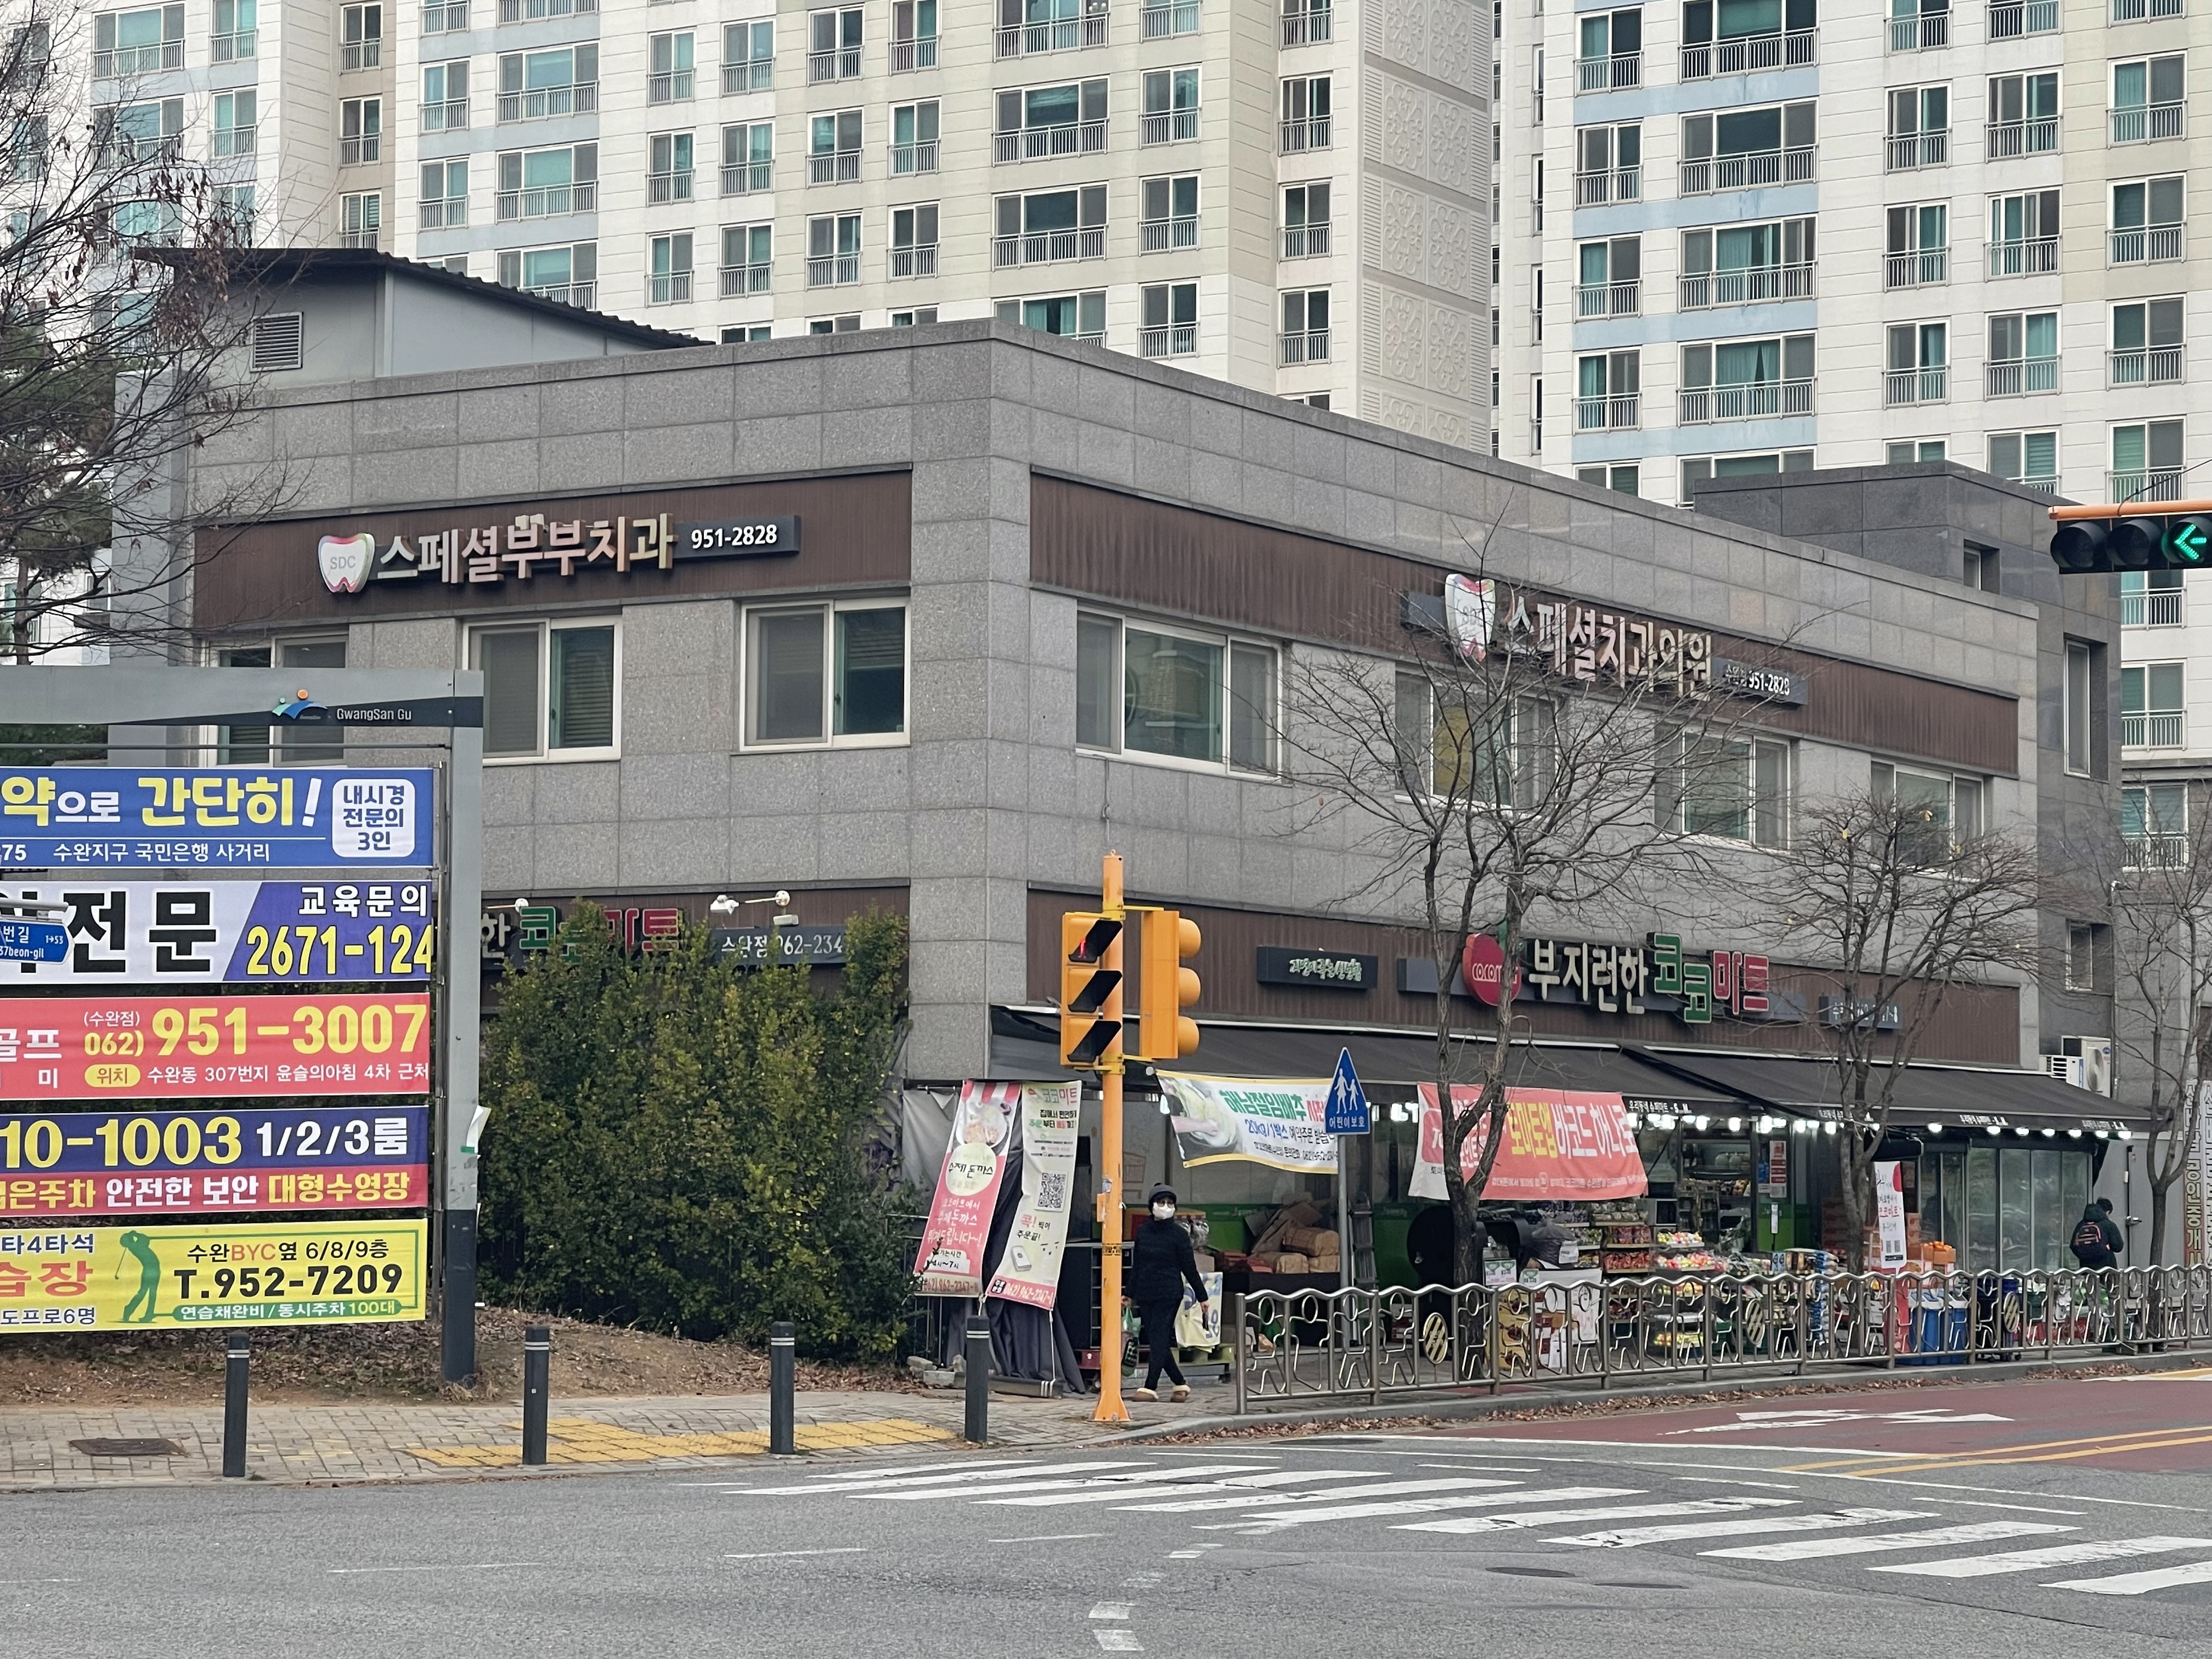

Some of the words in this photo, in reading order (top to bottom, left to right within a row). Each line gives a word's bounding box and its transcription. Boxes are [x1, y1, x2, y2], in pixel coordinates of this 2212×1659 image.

[377, 513, 674, 583] 스페셜부부치과
[691, 524, 778, 550] 951-2828
[329, 555, 356, 570] SDC
[336, 708, 394, 721] GwangSan
[397, 709, 412, 720] Gu
[138, 776, 322, 827] 간단히!
[343, 785, 405, 805] 내시경
[343, 808, 404, 827] 전문의
[53, 843, 128, 862] 수완지구
[134, 843, 209, 862] 국민은행
[216, 843, 270, 862] 사거리
[358, 831, 391, 851] 3인
[1528, 939, 1648, 1015] 부지런한
[1652, 932, 1770, 1024] 코코마트
[83, 1011, 140, 1027] (수완점)
[84, 1030, 144, 1057] 062)
[152, 1005, 427, 1056] 951-3007
[97, 1068, 128, 1085] 위치
[148, 1066, 197, 1084] 수완동
[205, 1065, 268, 1082] 307번지
[276, 1064, 356, 1082] 윤슬의아침
[364, 1064, 391, 1080] 4차
[398, 1062, 429, 1080] 근처
[1041, 1087, 1077, 1105] 코코마트
[1219, 1090, 1307, 1121] 해남절임배추
[1329, 1116, 1365, 1128] 어린이보호
[256, 1117, 408, 1157] 1/2/3룸
[106, 1176, 193, 1207] 안전한
[203, 1176, 259, 1205] 보안
[268, 1172, 410, 1204] 대형수영장
[187, 1242, 297, 1263] 수완BYC옆
[306, 1239, 389, 1261] 6/8/9층
[174, 1263, 402, 1299] T.952-7209
[349, 1301, 395, 1315] 100대
